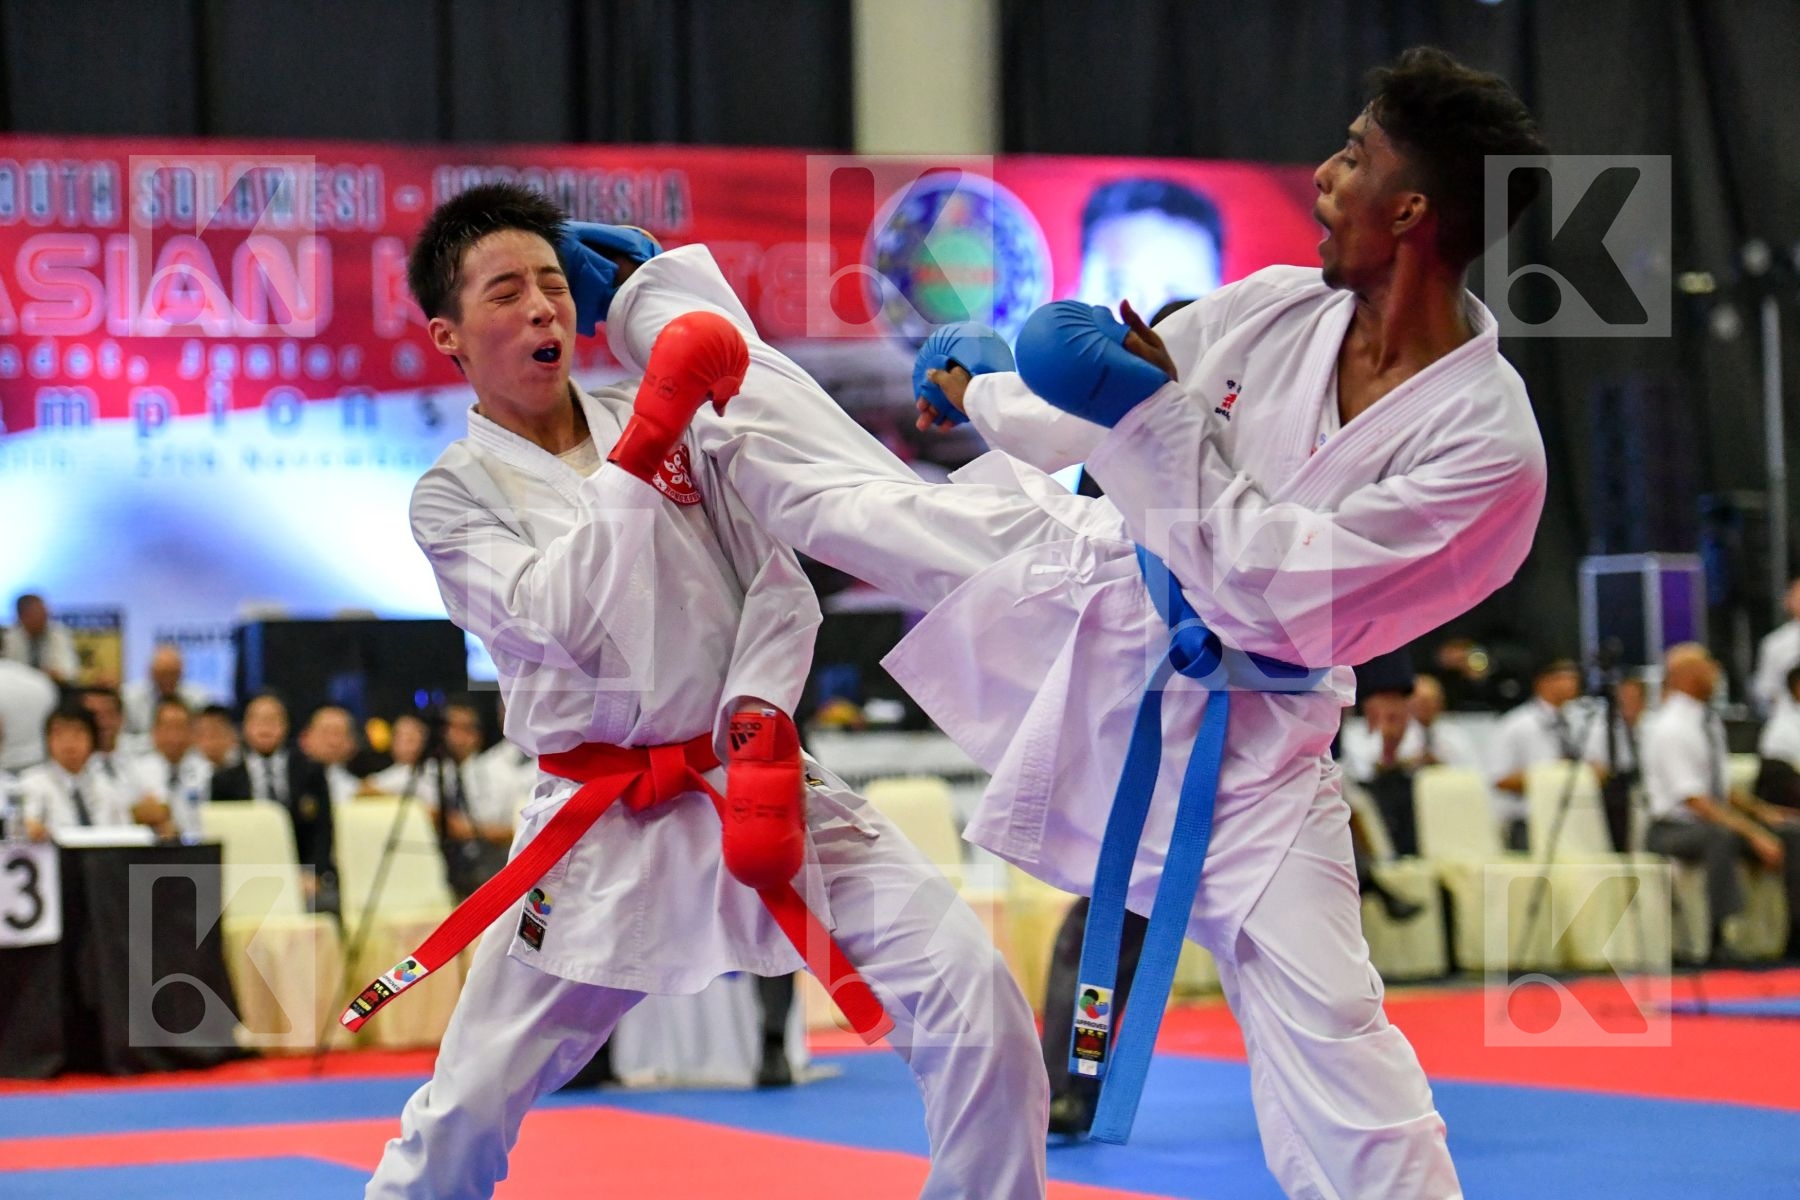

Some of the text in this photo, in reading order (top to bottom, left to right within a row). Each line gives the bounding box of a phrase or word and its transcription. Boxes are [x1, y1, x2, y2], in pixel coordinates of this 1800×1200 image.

[0, 233, 334, 338] SIAN
[0, 368, 442, 440] mpions
[5, 857, 43, 930] 3
